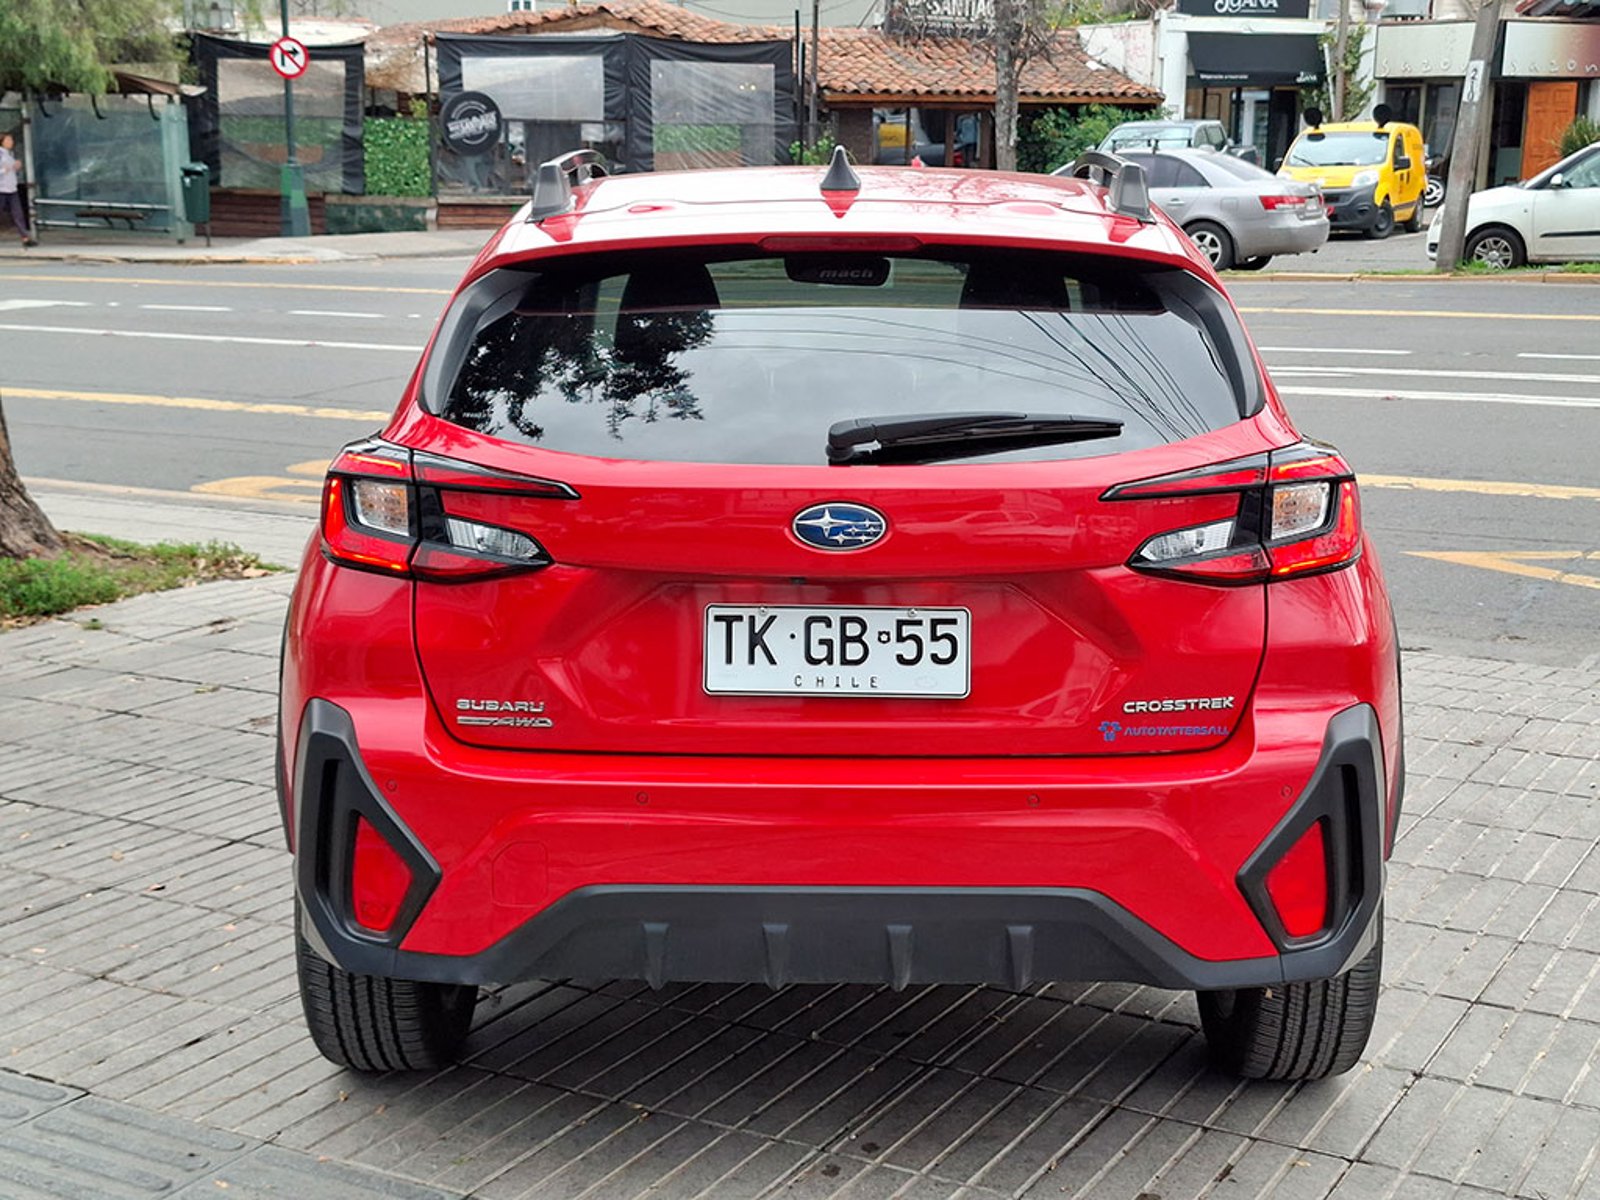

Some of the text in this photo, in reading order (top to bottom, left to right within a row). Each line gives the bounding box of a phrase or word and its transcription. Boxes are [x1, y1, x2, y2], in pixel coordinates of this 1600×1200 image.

[794, 675, 878, 688] CHILE
[456, 699, 545, 712] SUBARU
[1123, 696, 1235, 713] CROSSTREK
